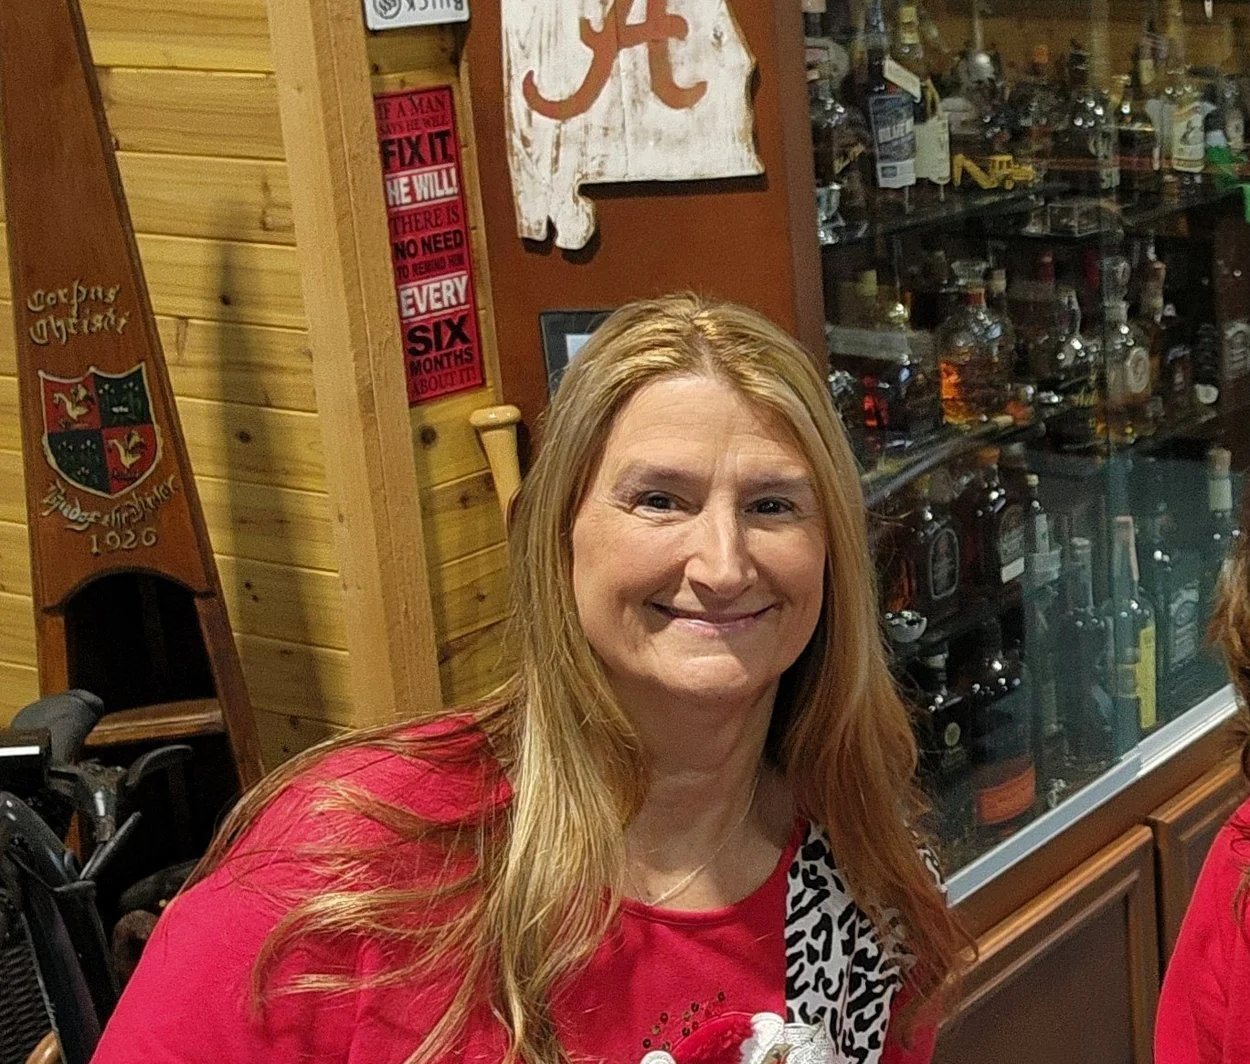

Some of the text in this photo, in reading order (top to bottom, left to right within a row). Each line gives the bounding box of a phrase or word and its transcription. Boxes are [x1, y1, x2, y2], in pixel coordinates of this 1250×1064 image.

[405, 0, 464, 12] BUICK
[522, 0, 708, 121] A
[379, 94, 448, 118] IF A MAN
[379, 115, 449, 136] SAYS HE WILL
[382, 134, 425, 171] FIX
[386, 167, 459, 206] HE WILL!
[391, 204, 460, 236] THERE IS
[394, 229, 464, 259] NO NEED
[396, 252, 465, 279] TO REMIND HIM
[27, 280, 120, 318] Corpus
[400, 275, 469, 318] EVERY
[30, 307, 131, 345] Christi
[407, 313, 471, 357] SIX
[409, 346, 474, 377] MONTHS
[410, 365, 477, 398] ABOUT IT!
